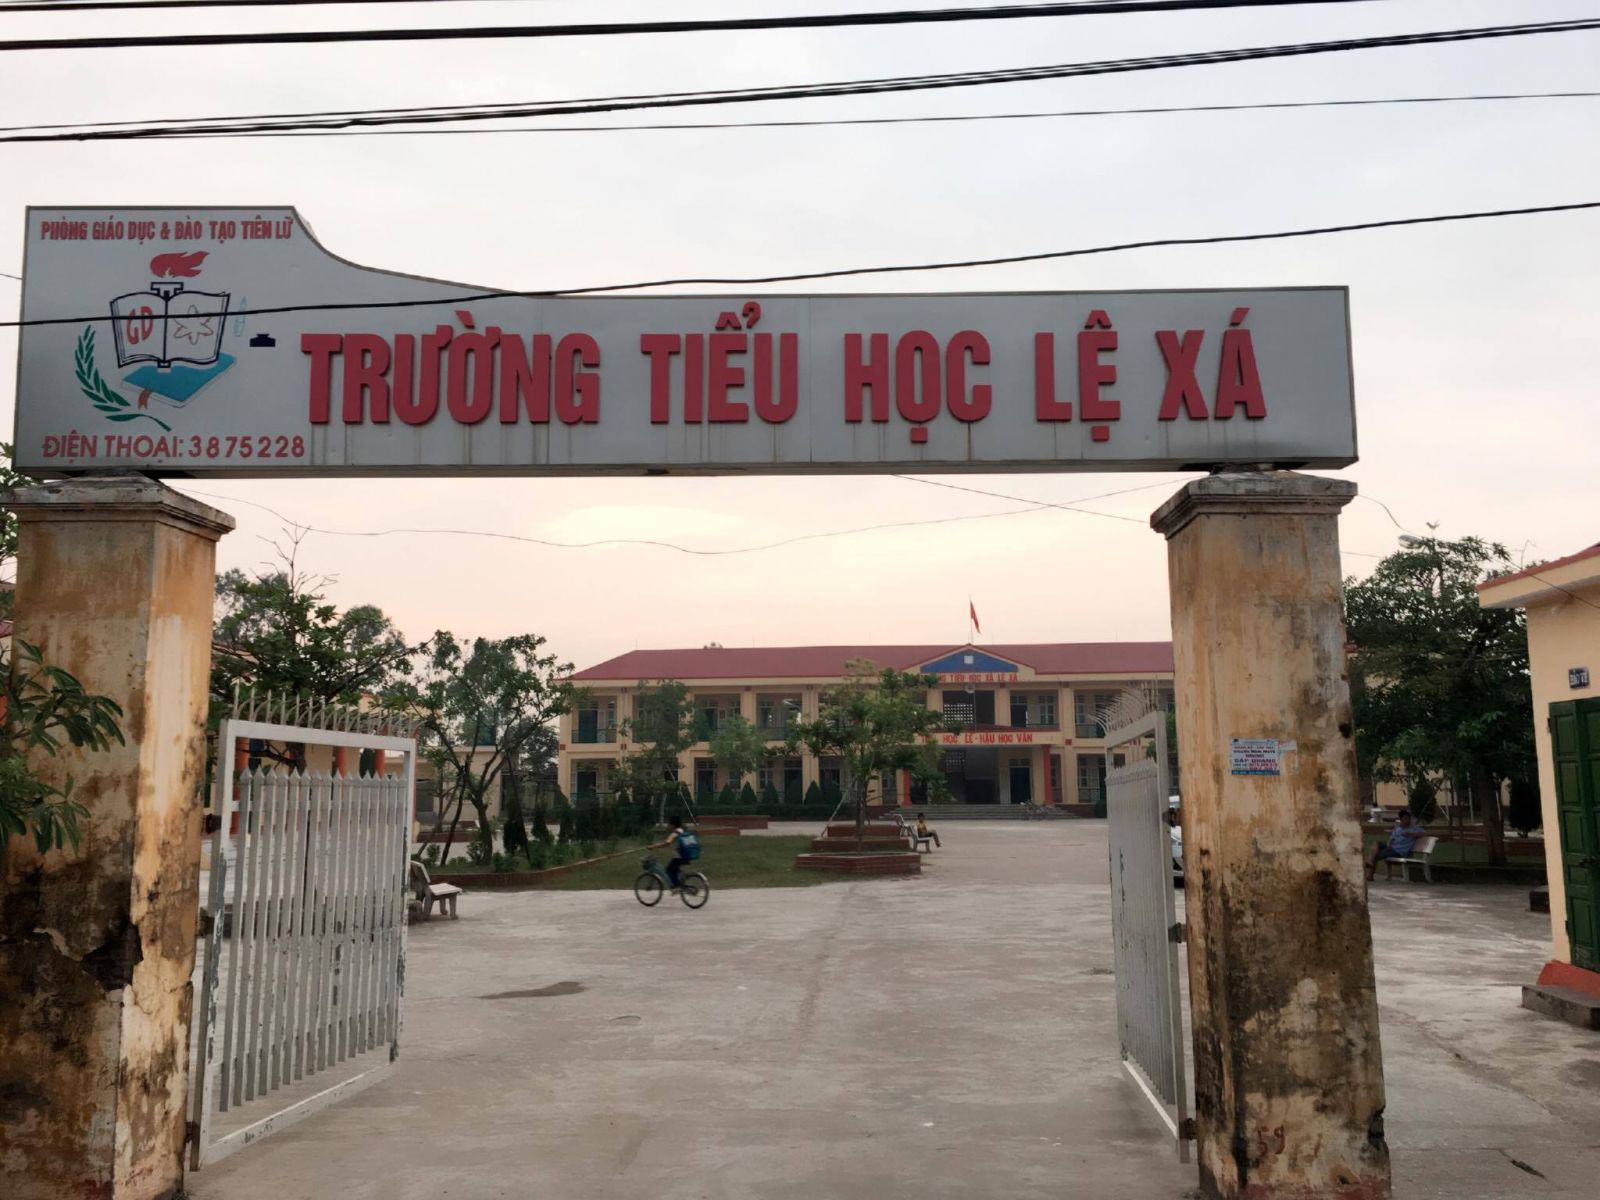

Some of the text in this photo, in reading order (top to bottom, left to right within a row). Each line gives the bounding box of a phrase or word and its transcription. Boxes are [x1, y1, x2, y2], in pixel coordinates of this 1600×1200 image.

[41, 216, 88, 240] PHÒNG
[92, 215, 124, 240] GIÁO
[128, 220, 155, 245] DỤC
[160, 220, 170, 240] &
[209, 219, 236, 245] TẠO
[240, 215, 272, 240] TIÊN
[275, 215, 294, 240] LỮ
[301, 302, 1267, 444] TRƯỜNG TIỂU HỌC LỆ XÁ
[42, 429, 97, 464] ĐIỆN
[189, 435, 305, 459] 3875228
